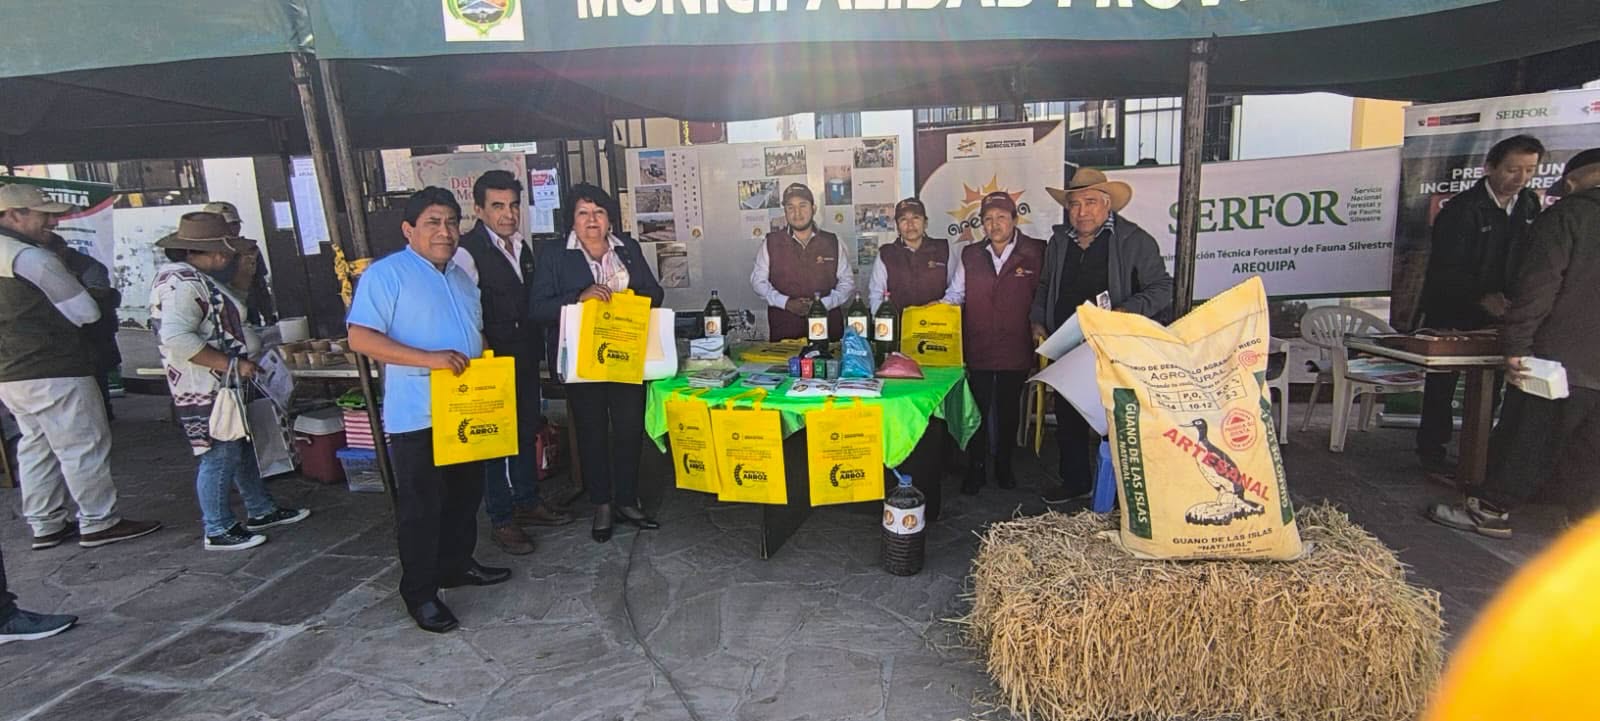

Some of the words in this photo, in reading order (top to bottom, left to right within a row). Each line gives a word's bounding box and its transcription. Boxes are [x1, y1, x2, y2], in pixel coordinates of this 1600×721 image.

[1495, 106, 1549, 121] SERFOR
[1538, 162, 1566, 176] UN
[1217, 246, 1251, 258] Técnica
[1253, 244, 1291, 256] Forestal
[1293, 247, 1300, 256] y
[1301, 244, 1313, 254] de
[1315, 243, 1346, 253] Fauna
[1348, 241, 1392, 251] Silvestre
[1231, 260, 1297, 274] AREQUIPA
[1192, 367, 1226, 383] URAL
[469, 426, 499, 436] ARROZ
[1125, 402, 1138, 445] GUANO
[1128, 448, 1139, 464] DE
[1162, 428, 1270, 501] ARTESANAL
[1130, 466, 1143, 489] LAS
[1134, 491, 1148, 523] ISLAS
[1172, 536, 1209, 545] GUANO
[1211, 535, 1225, 543] DE
[1226, 533, 1246, 542] LAS
[1248, 527, 1273, 540] ISLAS
